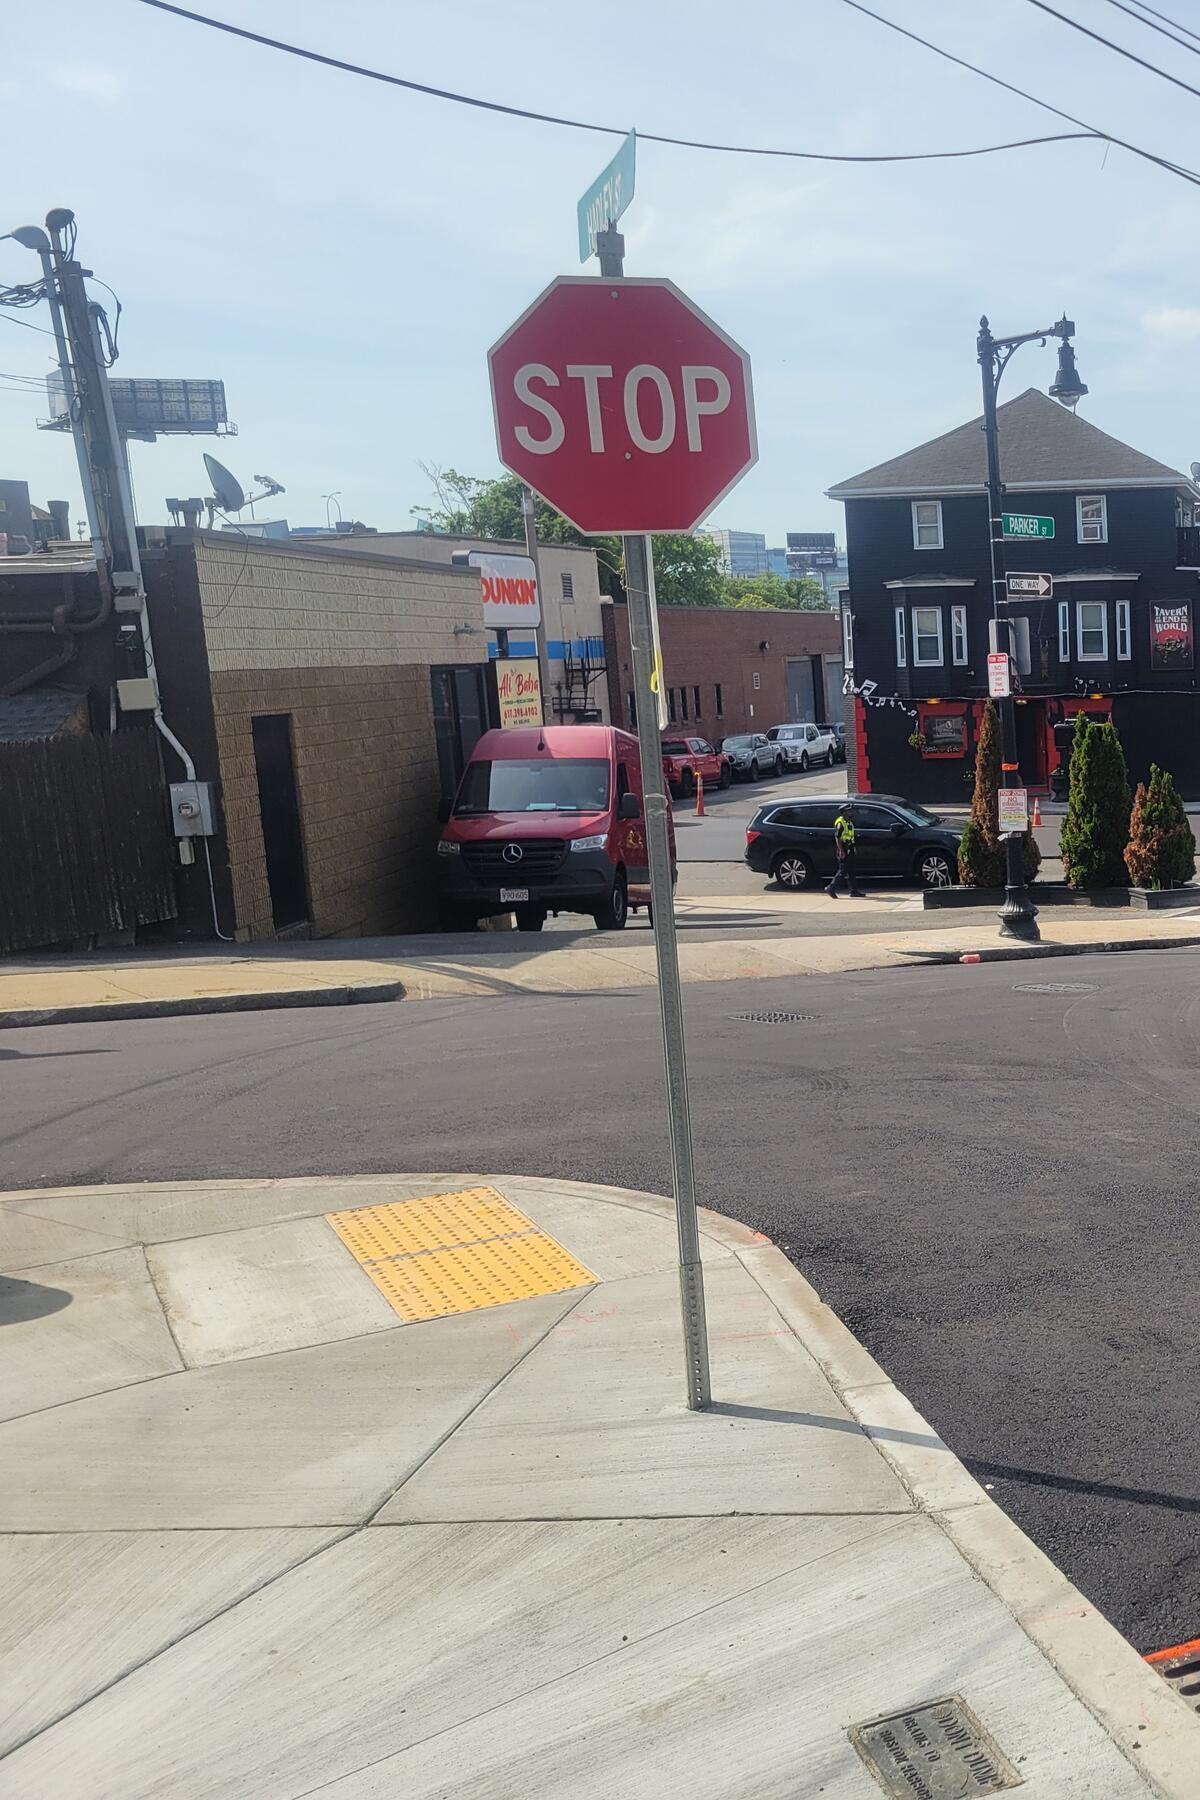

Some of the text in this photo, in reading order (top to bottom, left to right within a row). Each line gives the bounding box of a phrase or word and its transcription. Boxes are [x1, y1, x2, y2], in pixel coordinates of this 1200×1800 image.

[513, 363, 731, 454] STOP
[1009, 517, 1047, 535] PARKER ST
[1011, 580, 1039, 590] ONE WAY
[1154, 604, 1188, 617] TAVERN
[1155, 622, 1188, 633] WORLD
[962, 1751, 1004, 1787] DUMP
